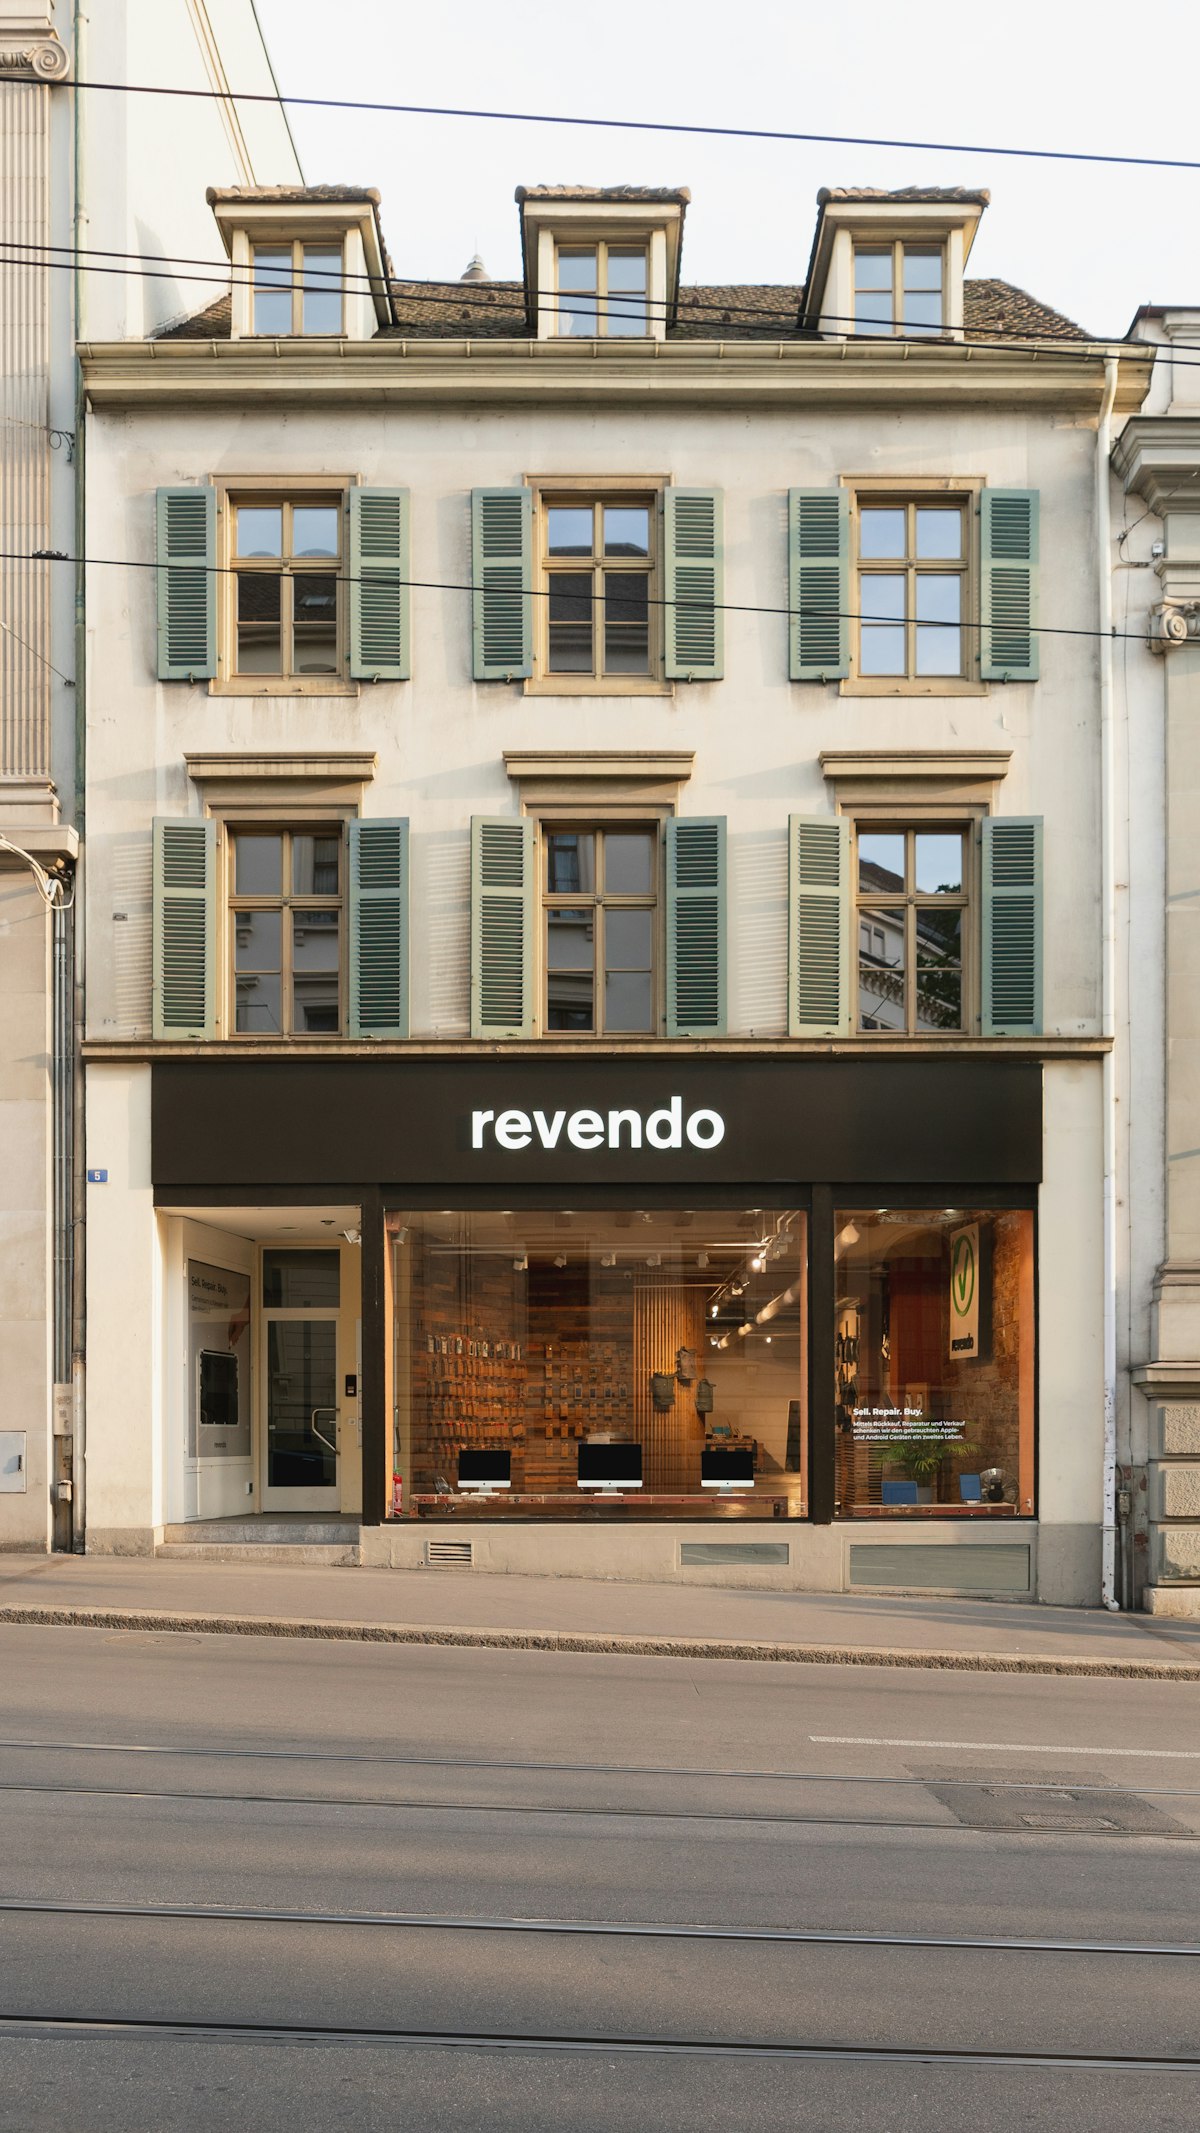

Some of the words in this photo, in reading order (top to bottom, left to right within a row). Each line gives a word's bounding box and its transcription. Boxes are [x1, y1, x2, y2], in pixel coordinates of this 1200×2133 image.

[472, 1095, 725, 1150] revendo
[94, 1171, 101, 1181] 5
[853, 1407, 871, 1416] Sell.
[872, 1407, 902, 1417] Repair.
[903, 1407, 923, 1417] Buy.
